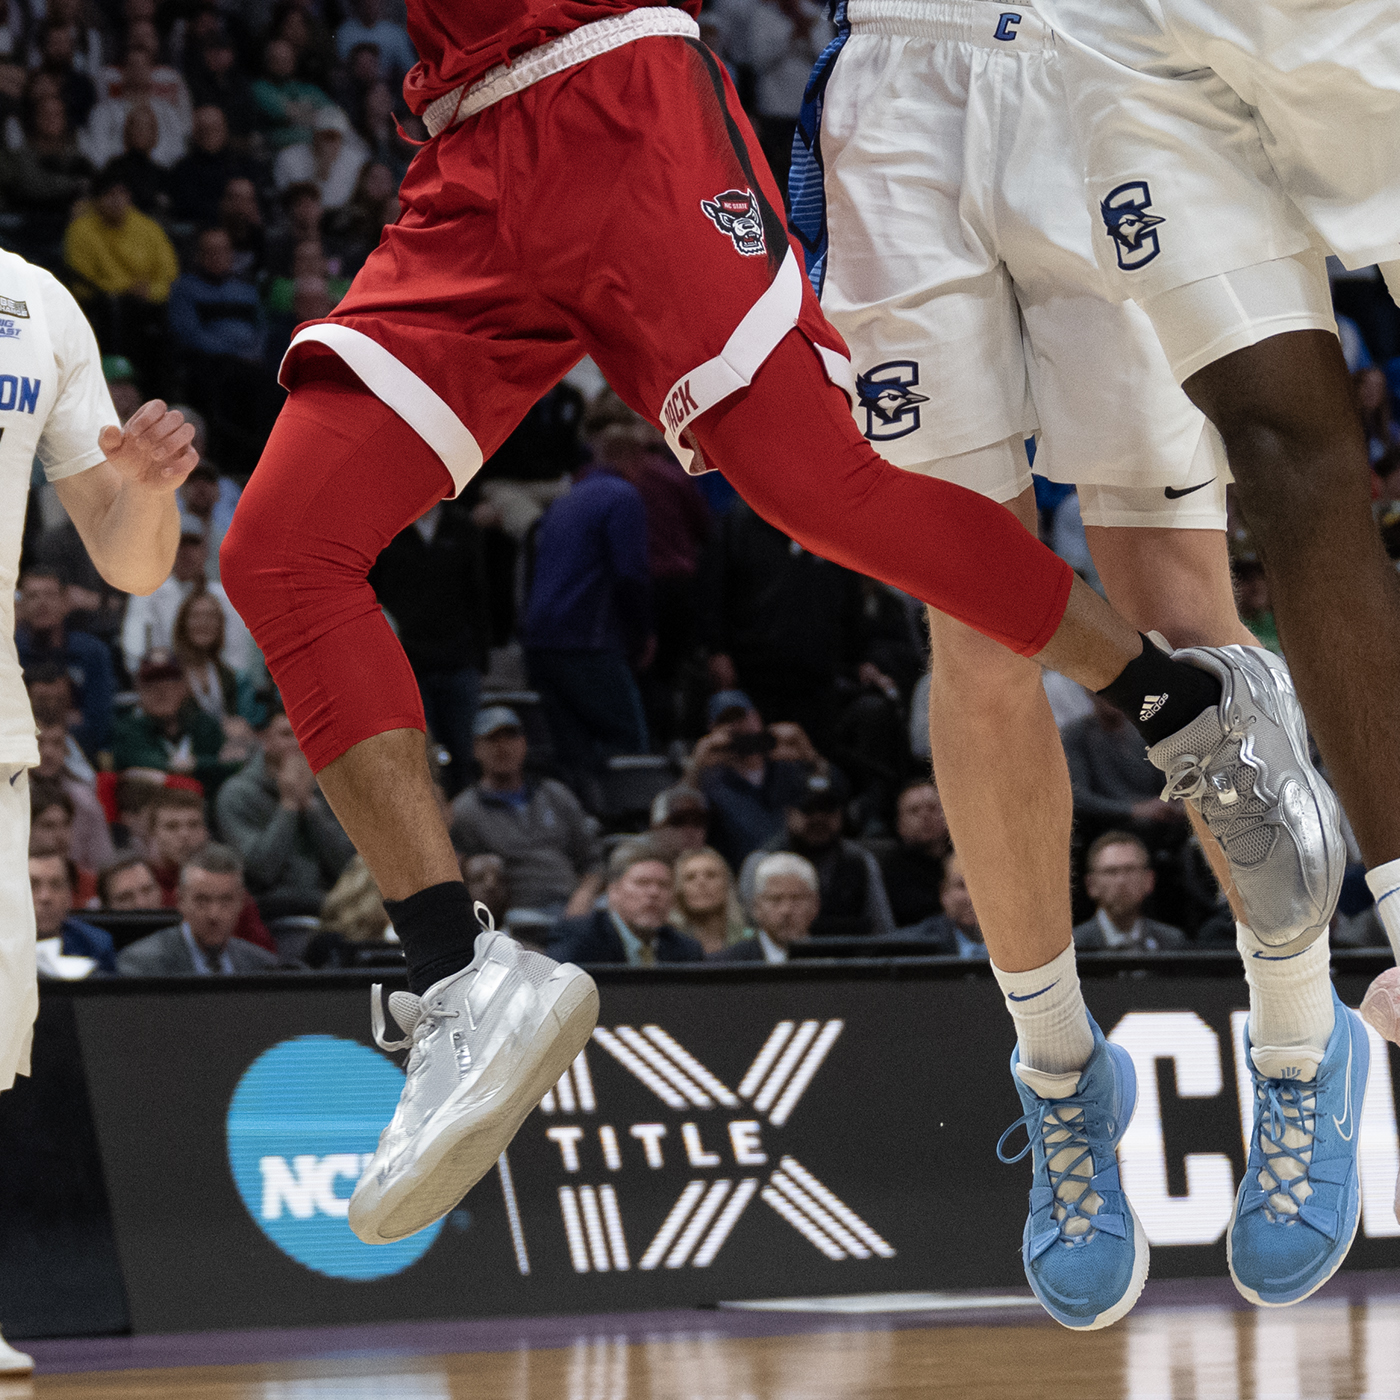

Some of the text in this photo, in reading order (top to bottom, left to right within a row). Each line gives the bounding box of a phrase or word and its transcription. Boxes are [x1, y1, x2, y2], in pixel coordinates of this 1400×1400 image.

[1139, 692, 1169, 722] adidas
[546, 1119, 767, 1172] TITLE
[259, 1152, 375, 1220] NC
